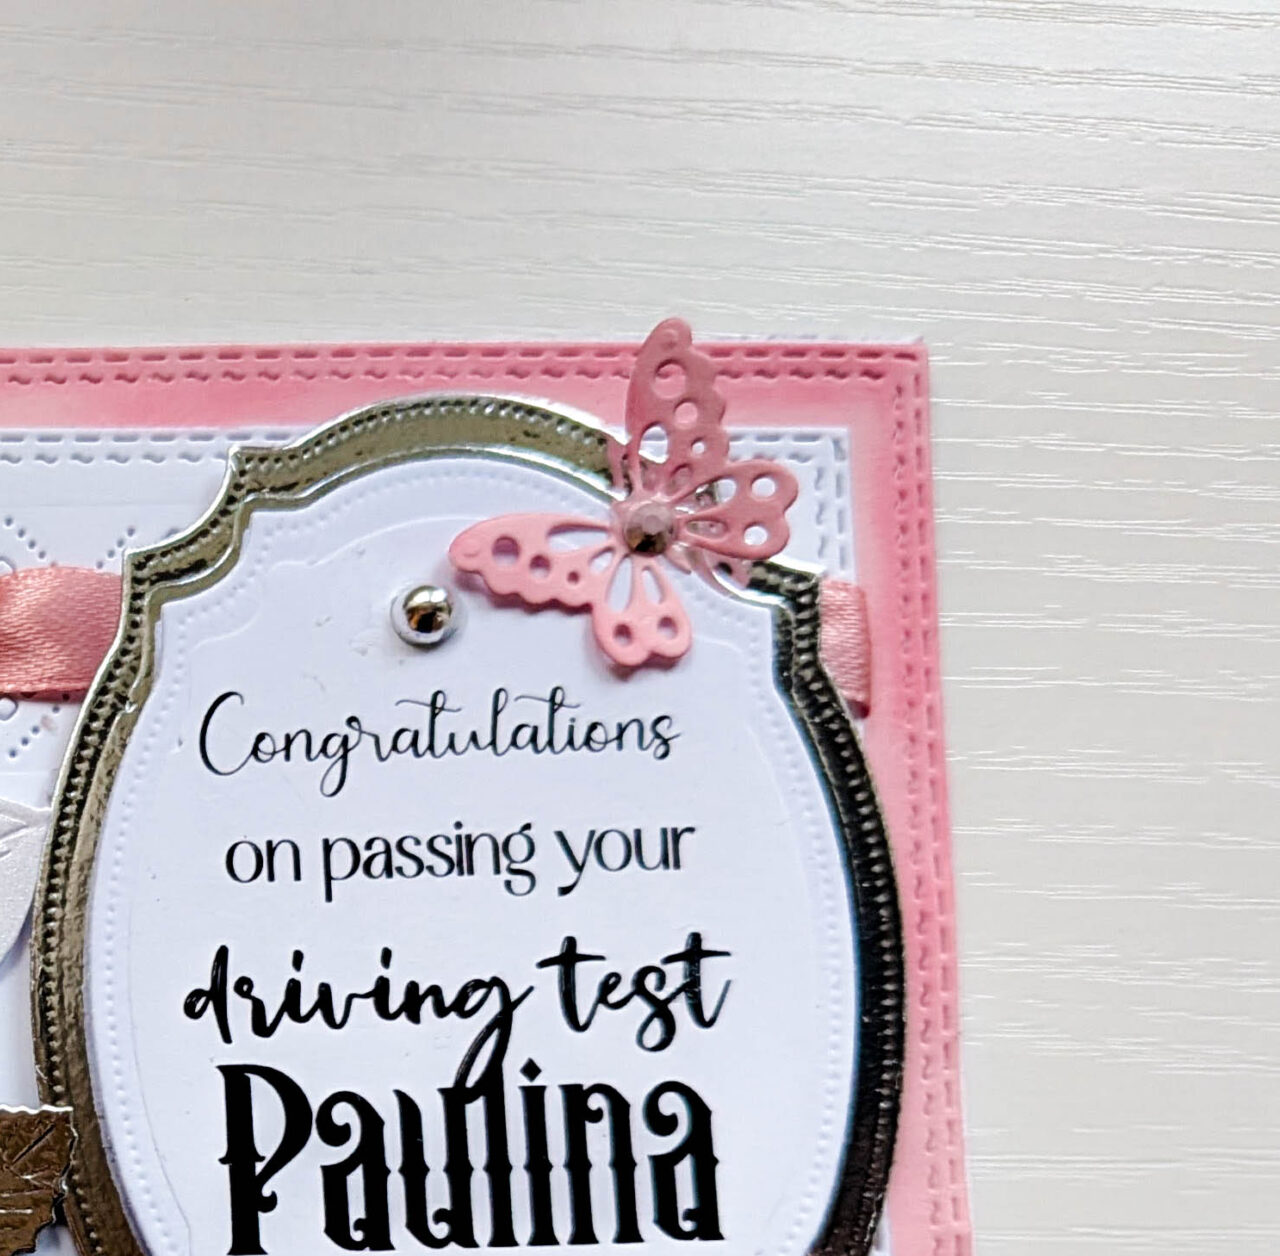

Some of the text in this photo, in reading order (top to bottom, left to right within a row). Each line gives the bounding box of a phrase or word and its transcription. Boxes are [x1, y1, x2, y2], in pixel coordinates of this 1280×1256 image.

[198, 685, 681, 798] Congratulations
[225, 820, 697, 903] on passing your
[183, 931, 732, 1103] driving test
[215, 1052, 726, 1256] Paulina
